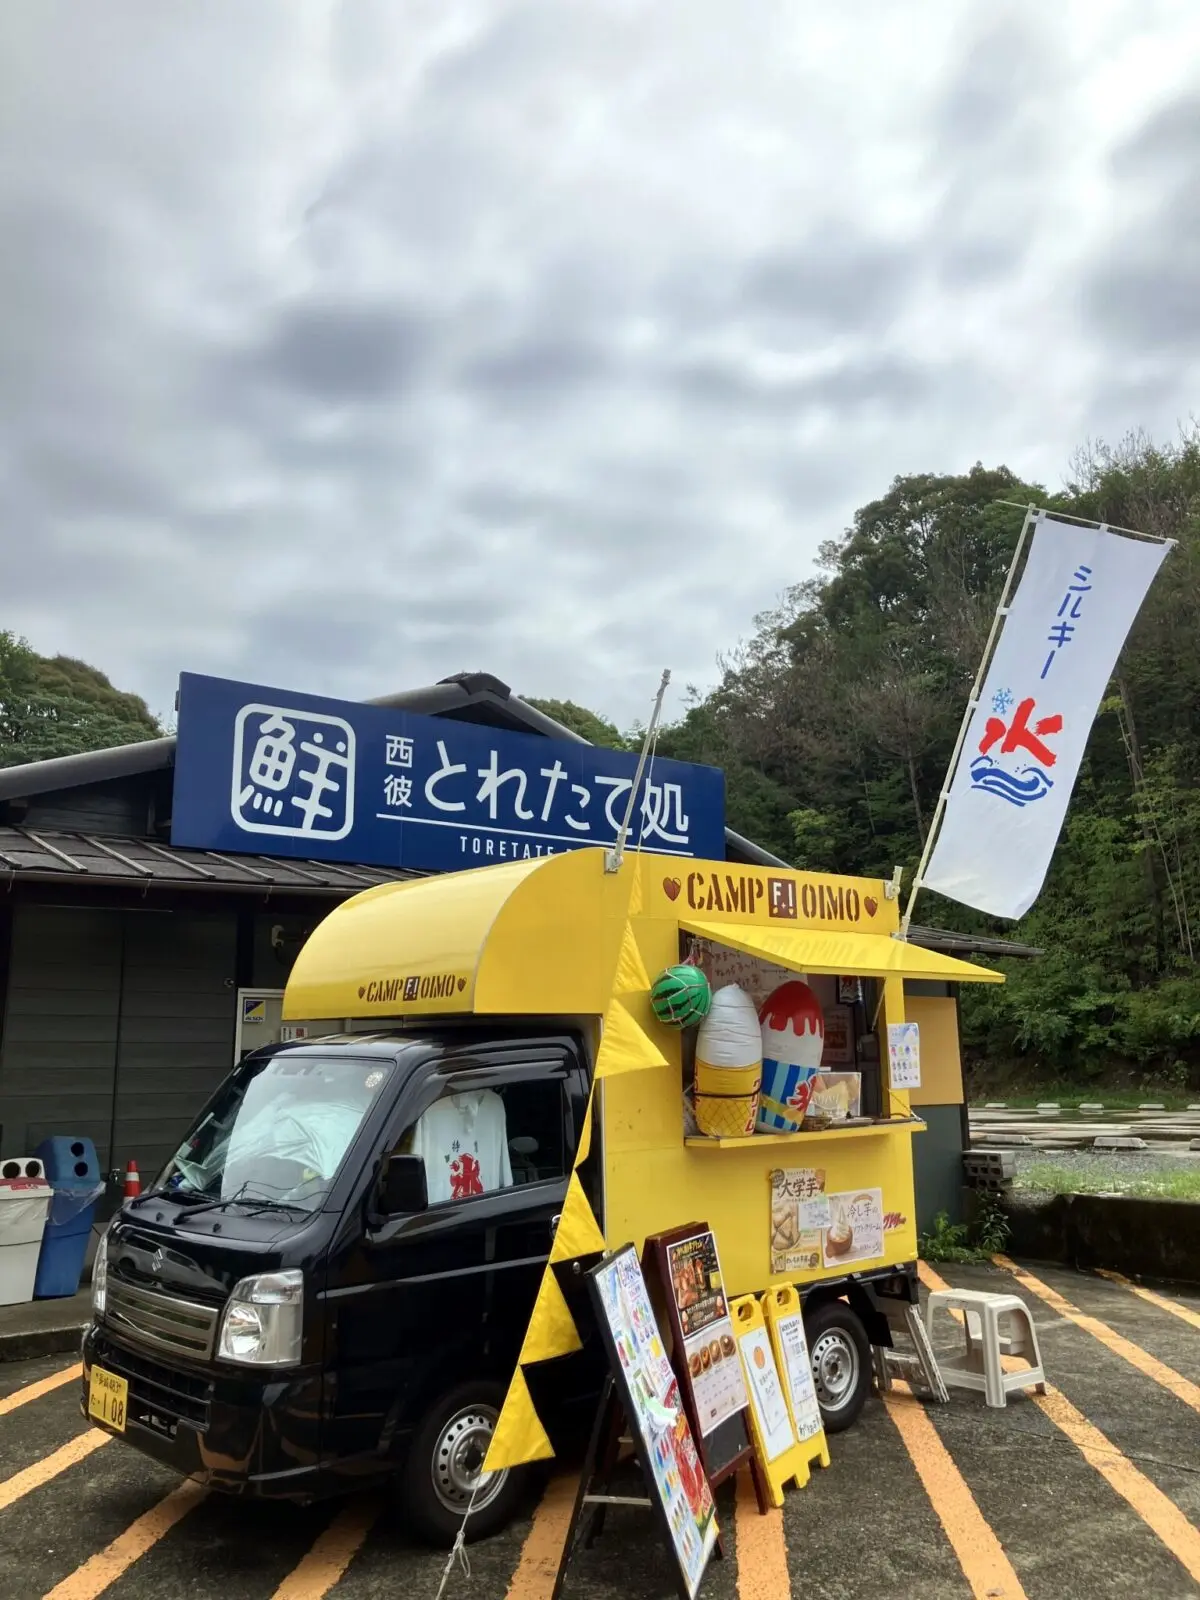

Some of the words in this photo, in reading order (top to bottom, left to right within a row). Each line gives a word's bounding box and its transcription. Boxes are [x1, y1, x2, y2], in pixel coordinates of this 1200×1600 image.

[1039, 565, 1092, 679] ミルキー
[236, 707, 350, 836] 鮮
[383, 734, 414, 809] 西彼
[424, 739, 690, 845] とれたて処
[687, 872, 764, 914] CAMP
[802, 883, 861, 922] OIMO
[366, 979, 404, 1002] CAMP
[420, 974, 456, 999] OIMO
[779, 1177, 818, 1199] 大学芋
